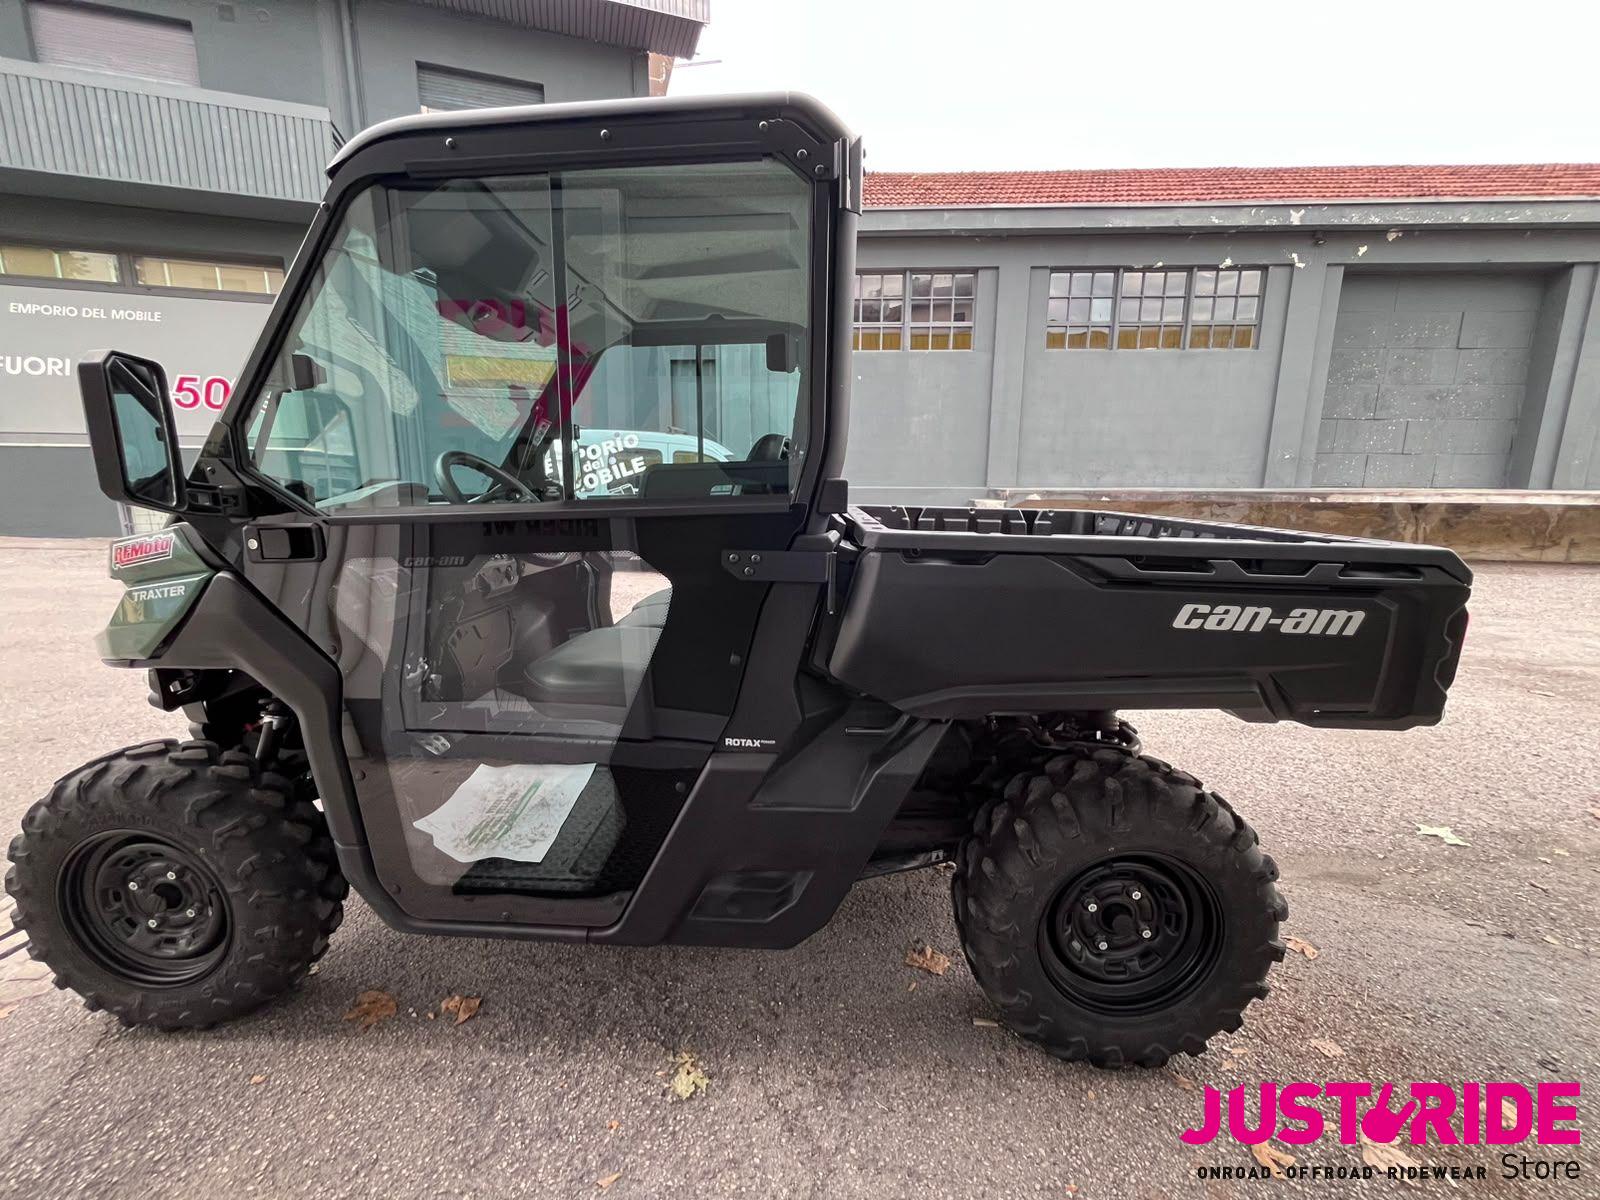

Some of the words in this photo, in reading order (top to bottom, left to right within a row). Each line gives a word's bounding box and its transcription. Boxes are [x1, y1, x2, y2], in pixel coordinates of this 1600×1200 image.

[9, 302, 78, 317] EMPORIO
[81, 307, 108, 319] DEL
[111, 309, 163, 322] MOBILE
[582, 459, 605, 473] del
[132, 586, 186, 602] TRAXTER
[1172, 603, 1366, 636] can-am
[724, 737, 761, 748] ROTAX
